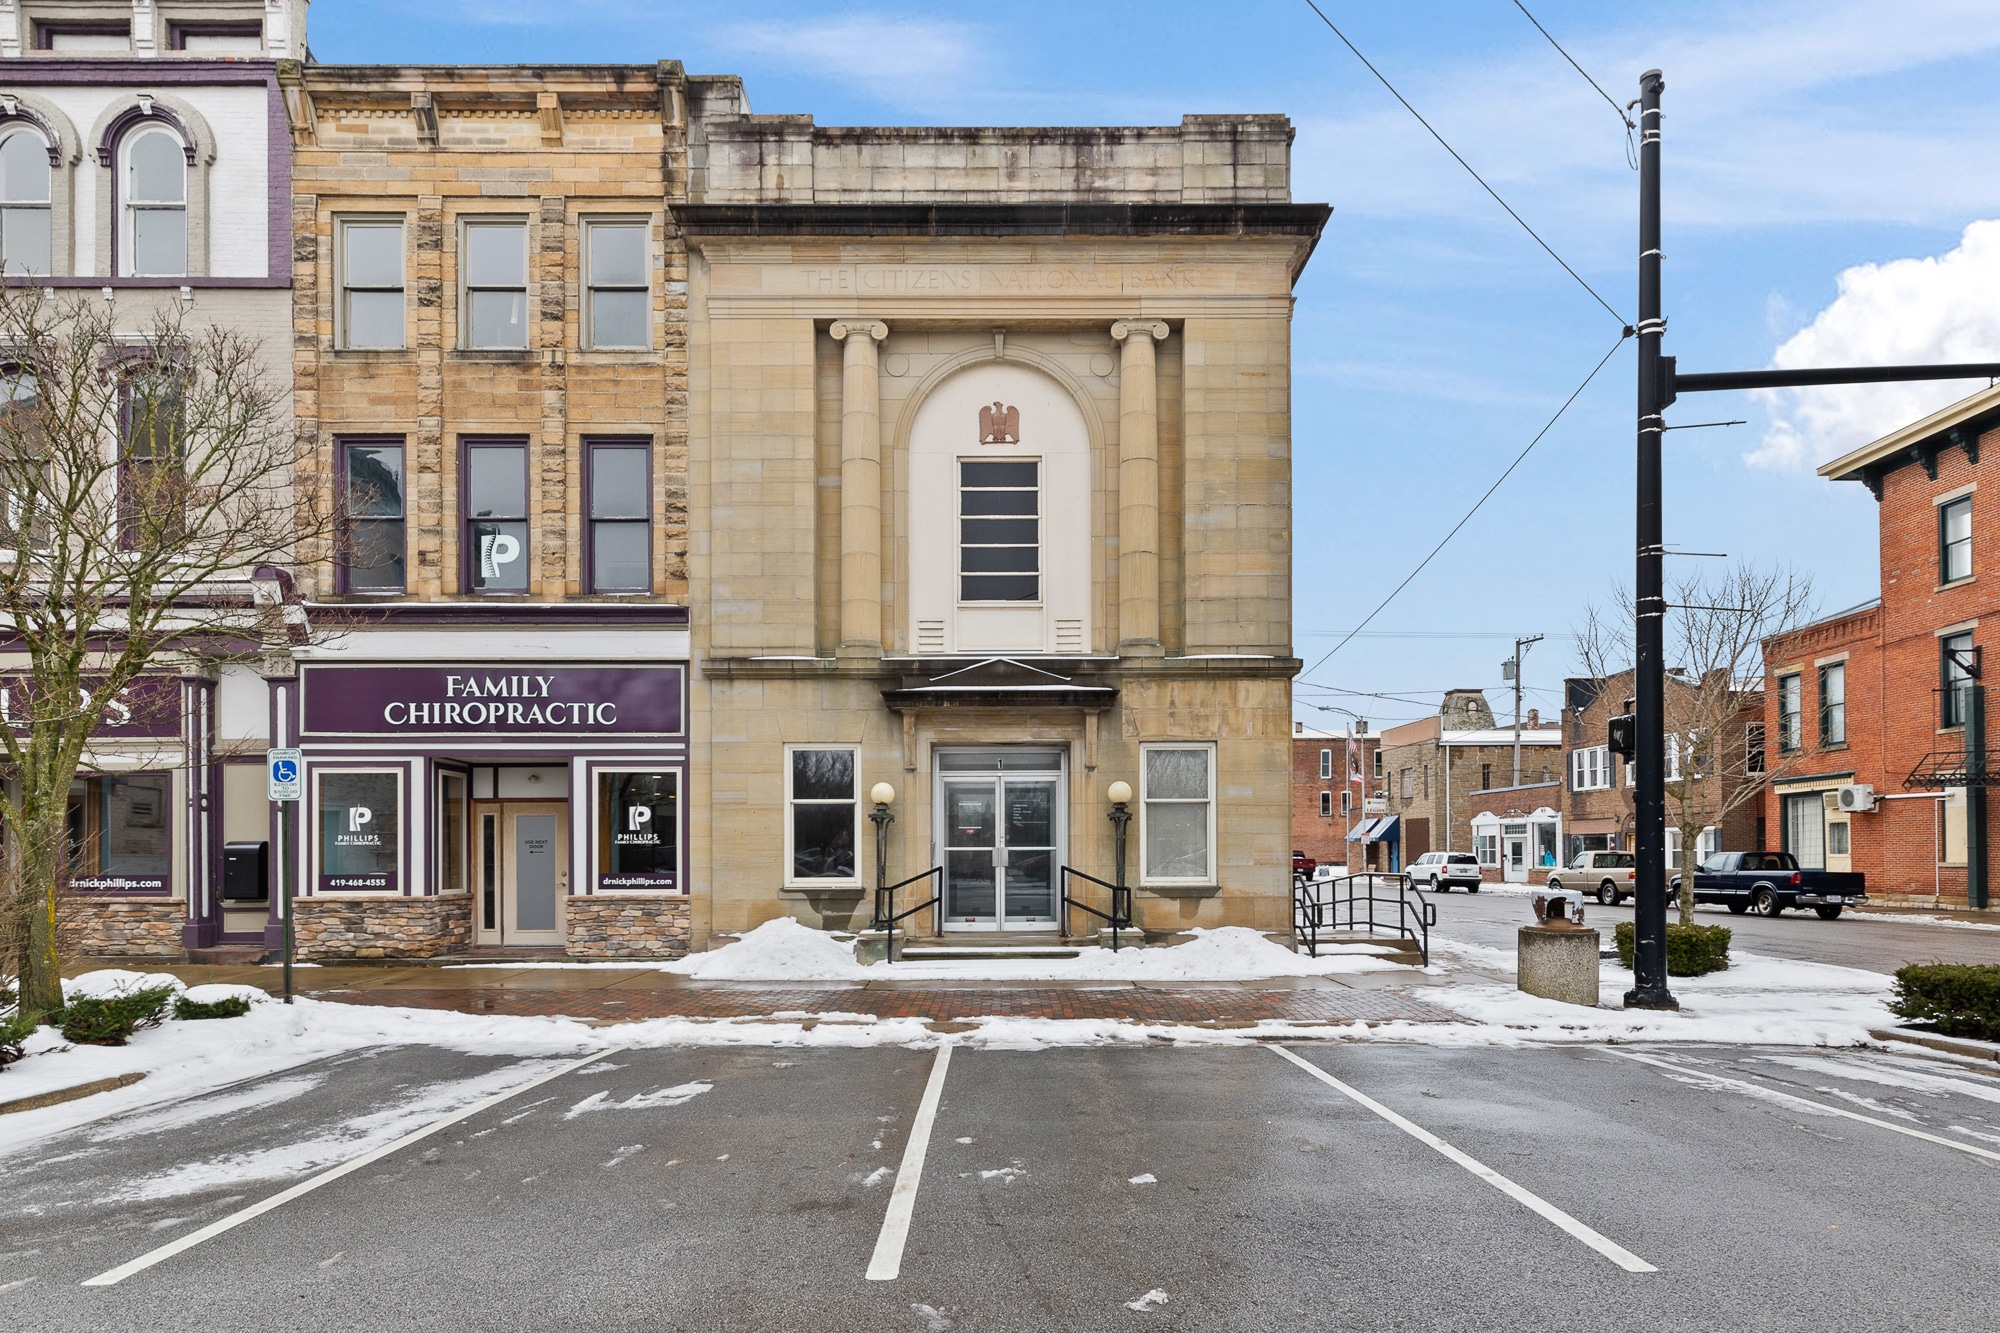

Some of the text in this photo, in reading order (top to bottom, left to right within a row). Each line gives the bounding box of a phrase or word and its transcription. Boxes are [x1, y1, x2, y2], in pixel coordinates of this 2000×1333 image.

[801, 268, 1196, 290] THE CITIZENS NATIONAL BANK
[445, 675, 555, 698] FAMILY
[383, 701, 618, 726] CHIROPRACTIC
[998, 758, 1003, 769] 1
[617, 833, 659, 841] PHILLIPS
[69, 878, 162, 890] drnickphillips.com
[602, 877, 673, 887] drnickphillips.com
